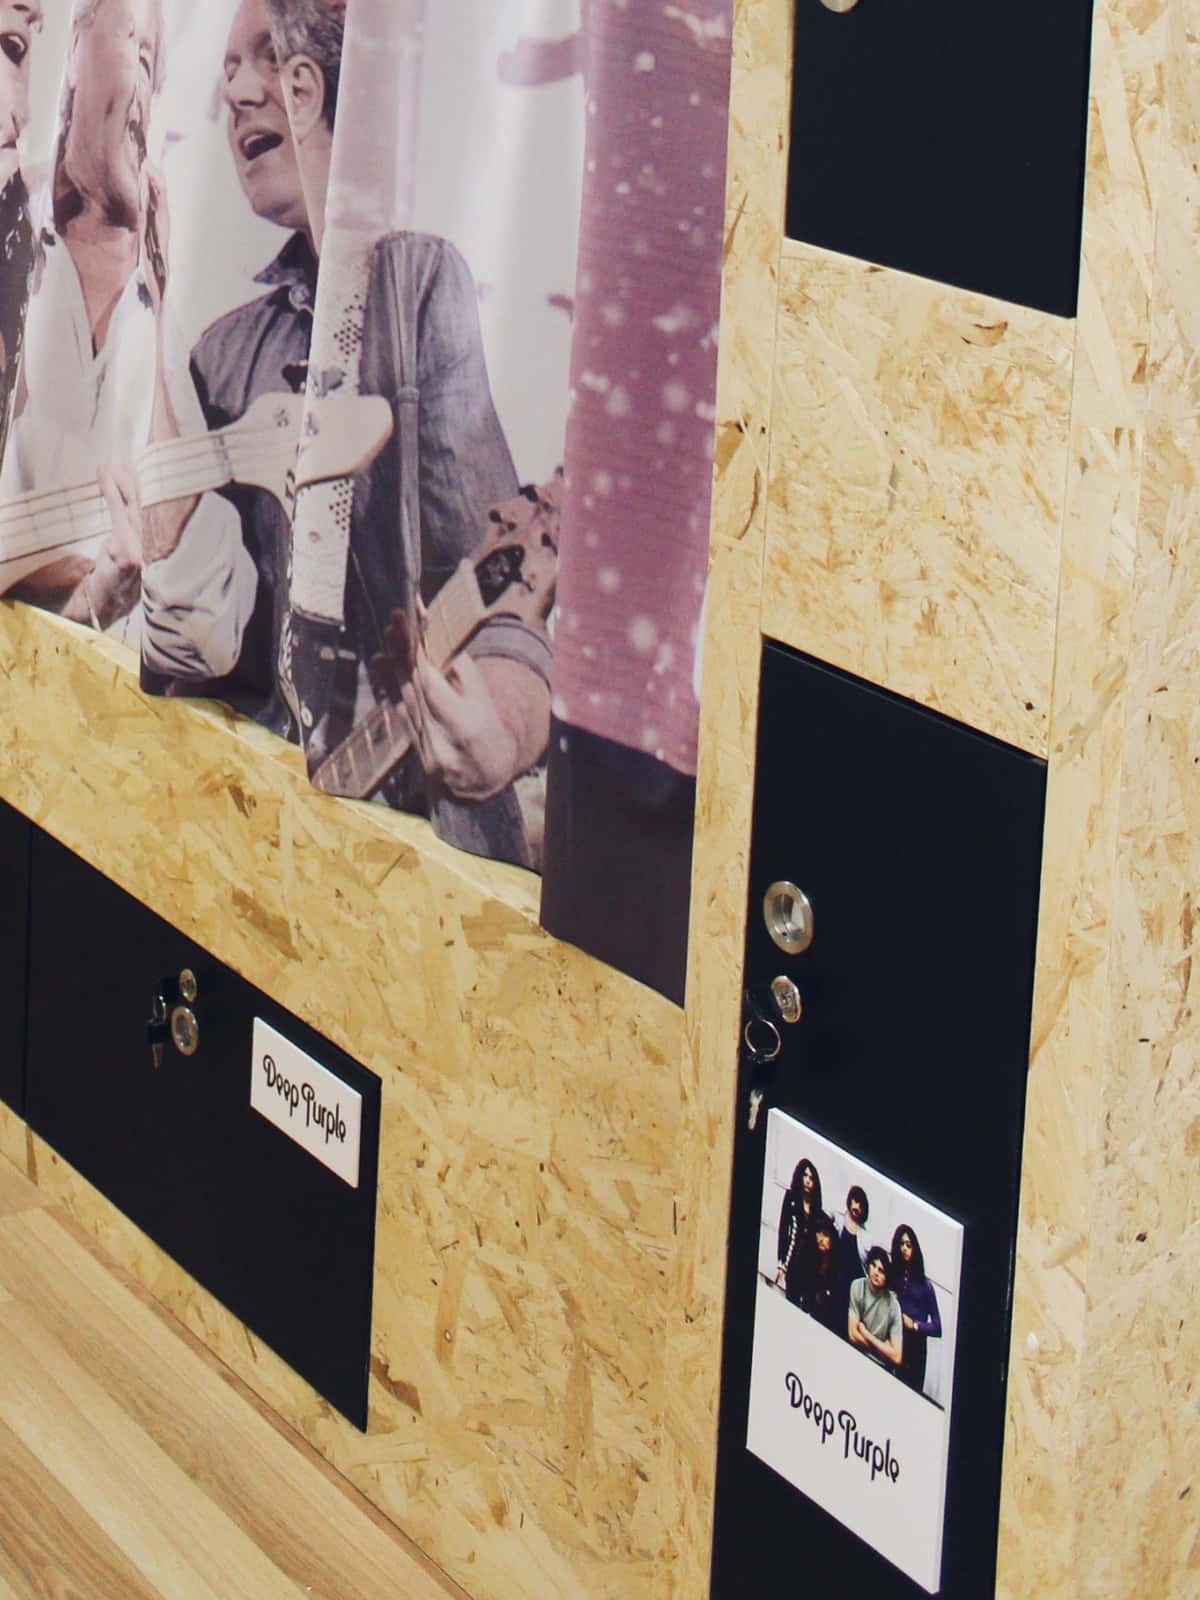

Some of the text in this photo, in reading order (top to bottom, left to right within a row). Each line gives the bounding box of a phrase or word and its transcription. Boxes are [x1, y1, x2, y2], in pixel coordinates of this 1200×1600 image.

[263, 1054, 346, 1144] Deep Purple
[785, 1372, 900, 1483] Deep Purple
